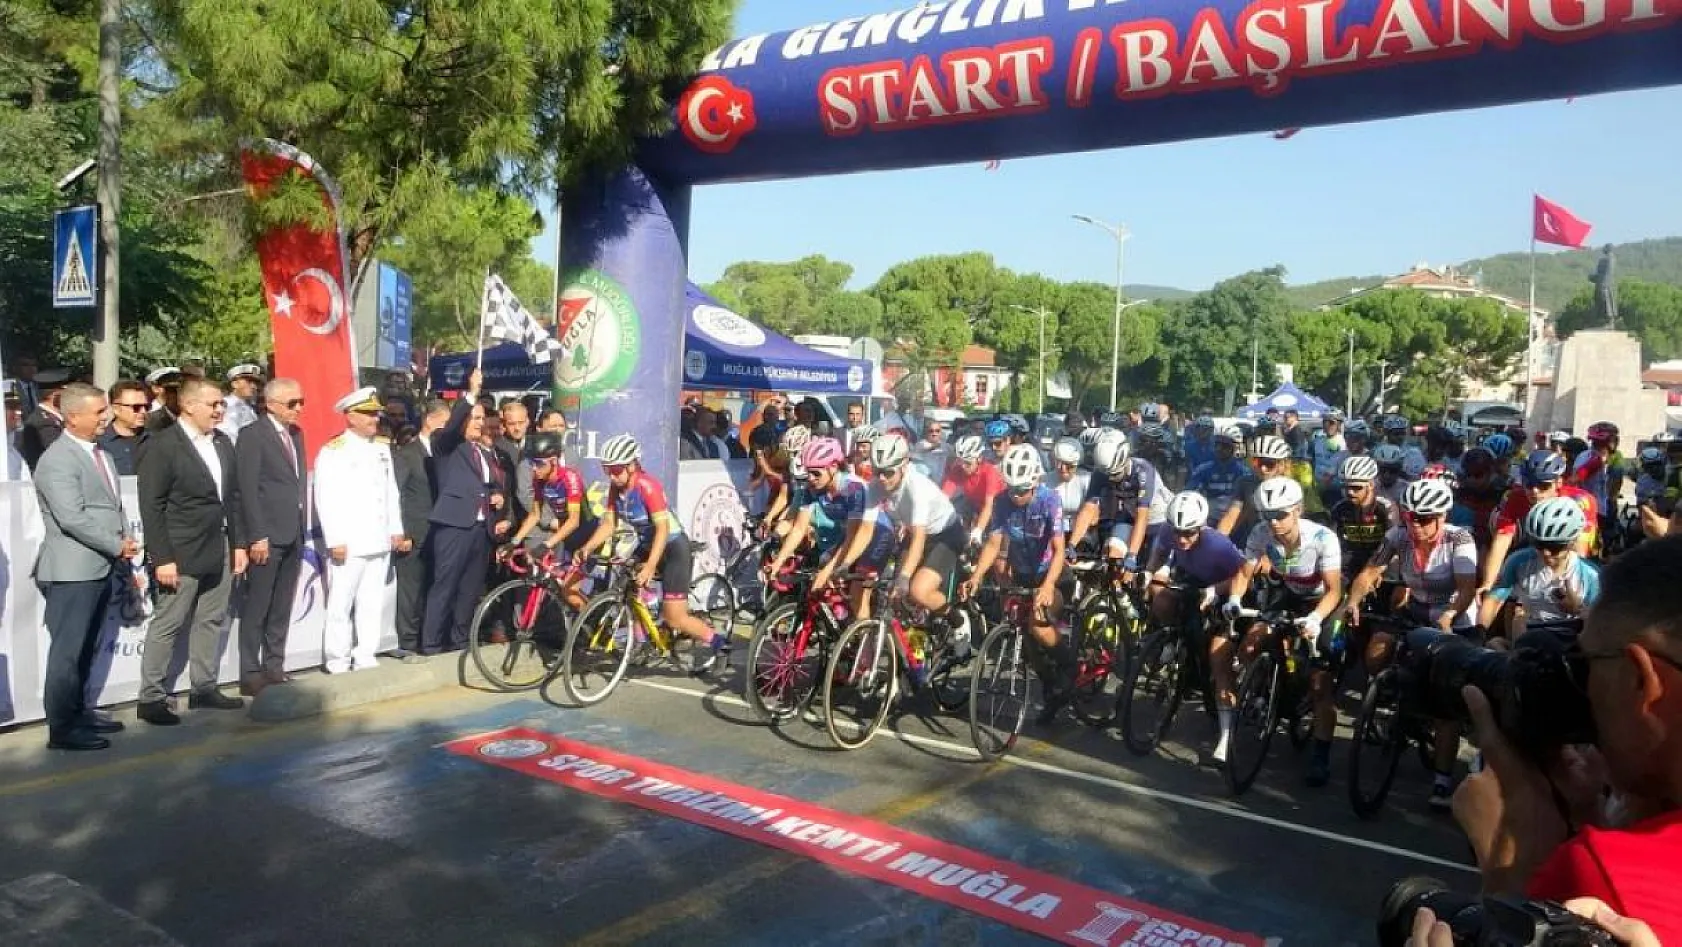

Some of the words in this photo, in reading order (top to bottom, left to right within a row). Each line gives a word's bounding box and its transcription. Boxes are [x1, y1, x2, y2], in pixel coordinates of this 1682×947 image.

[823, 46, 1046, 131] START
[1075, 38, 1094, 101] /
[538, 754, 635, 785] SPOR
[621, 775, 782, 827] TURİZMİ
[765, 814, 901, 863] KENTİ
[886, 850, 1061, 920] MUĞLA
